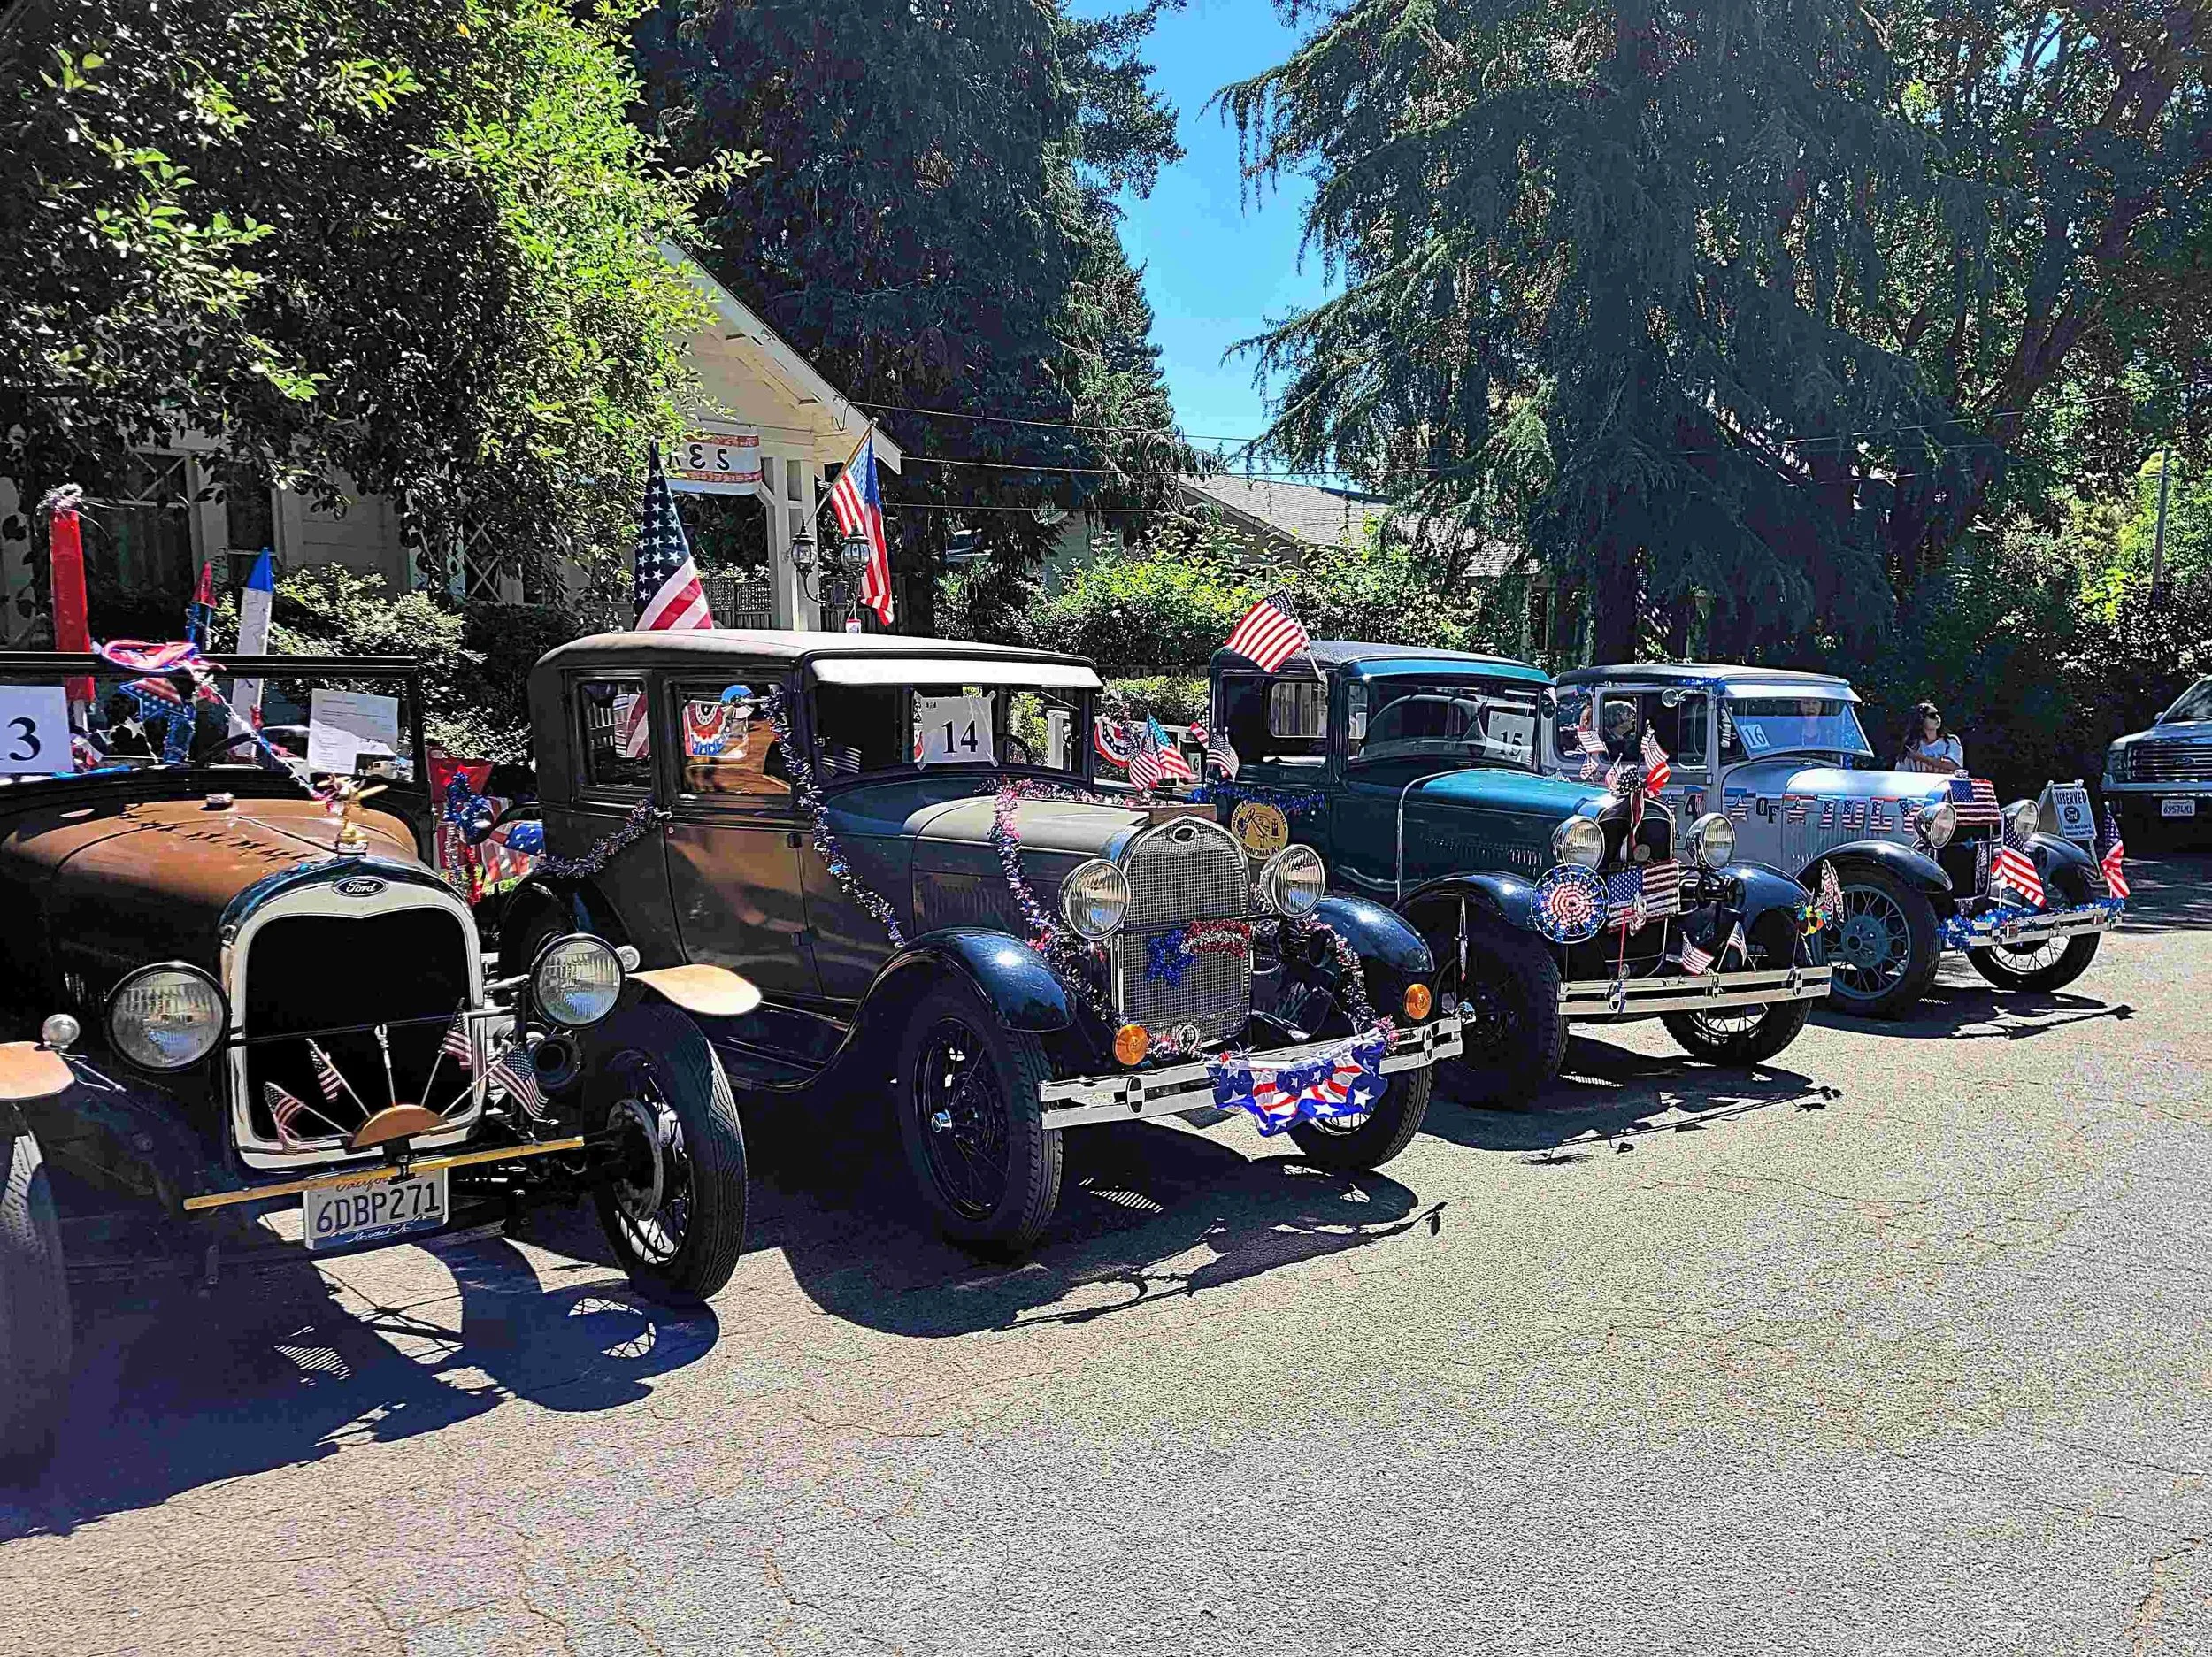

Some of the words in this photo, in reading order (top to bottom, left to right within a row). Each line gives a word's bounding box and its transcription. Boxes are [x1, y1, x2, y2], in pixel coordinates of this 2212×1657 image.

[0, 717, 41, 761] 3
[941, 720, 979, 753] 14
[1744, 725, 1766, 746] 16
[2055, 790, 2087, 805] RESERVED
[1818, 799, 1924, 832] JULY
[1241, 842, 1271, 857] SONOMA
[346, 880, 378, 893] Ford
[316, 1181, 440, 1233] 6DBP271
